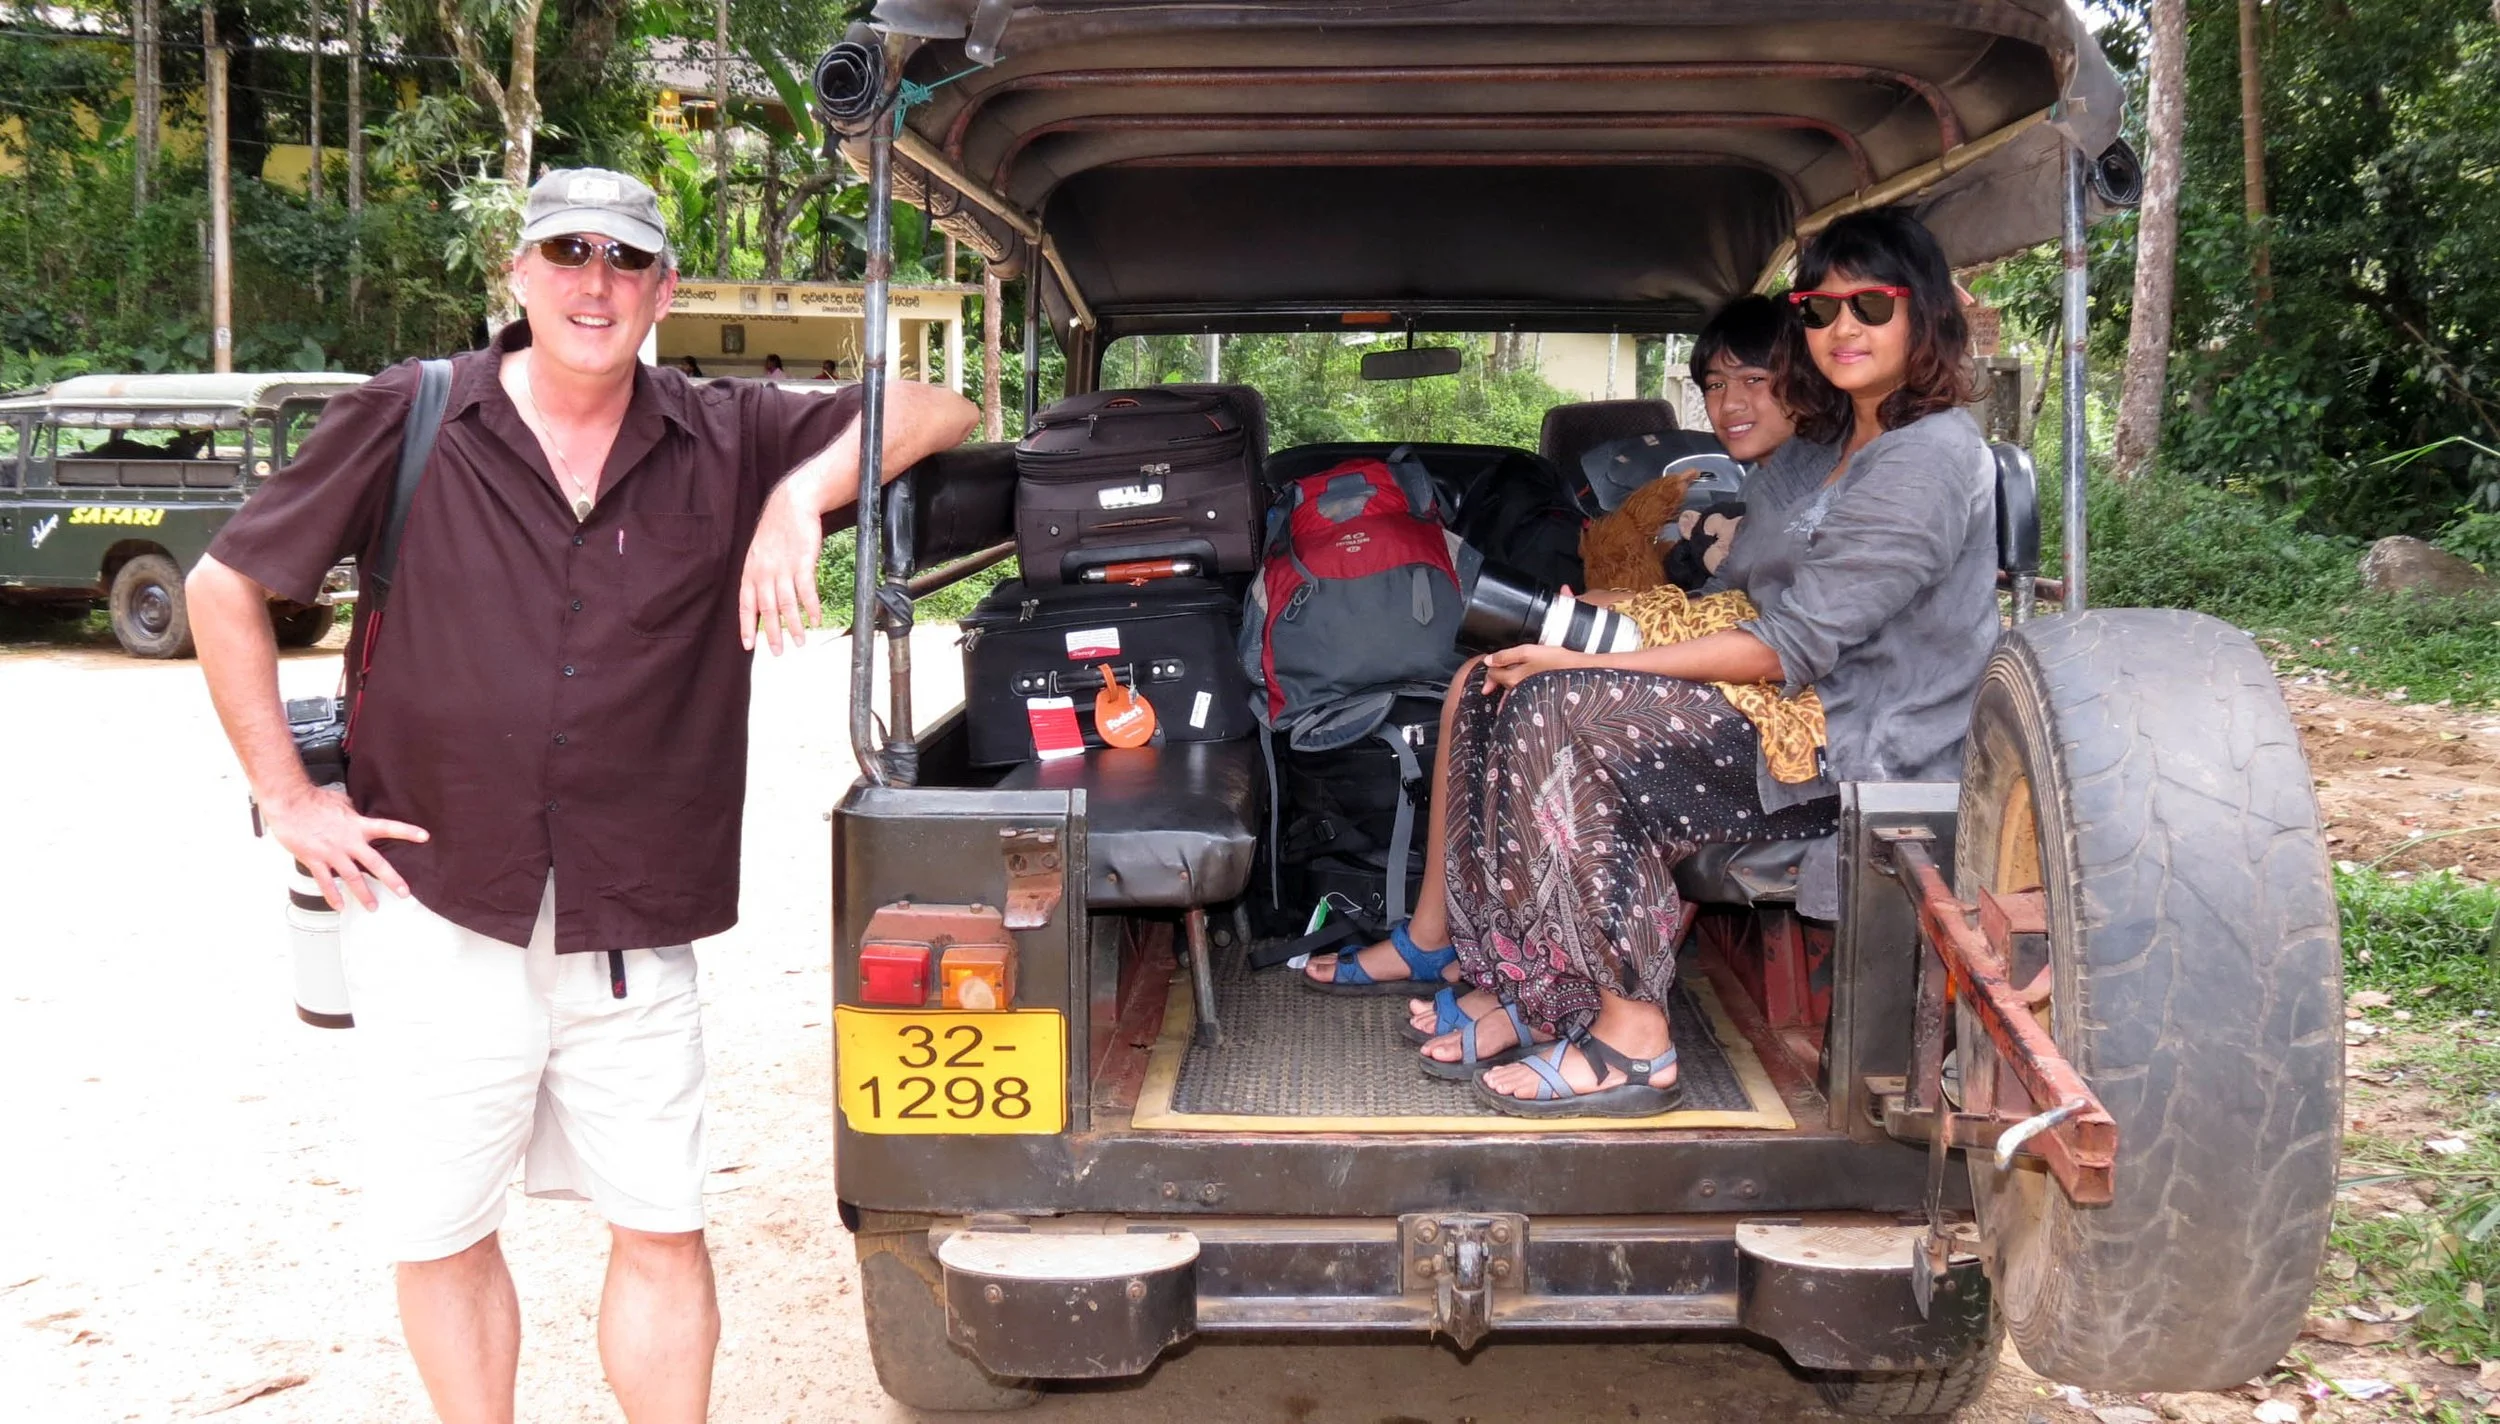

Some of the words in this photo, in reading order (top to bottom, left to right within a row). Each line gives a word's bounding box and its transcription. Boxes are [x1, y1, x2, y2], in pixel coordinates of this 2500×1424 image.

[69, 508, 165, 526] SAFARI
[898, 1025, 1016, 1069] 32-
[859, 1076, 1031, 1119] 1298
